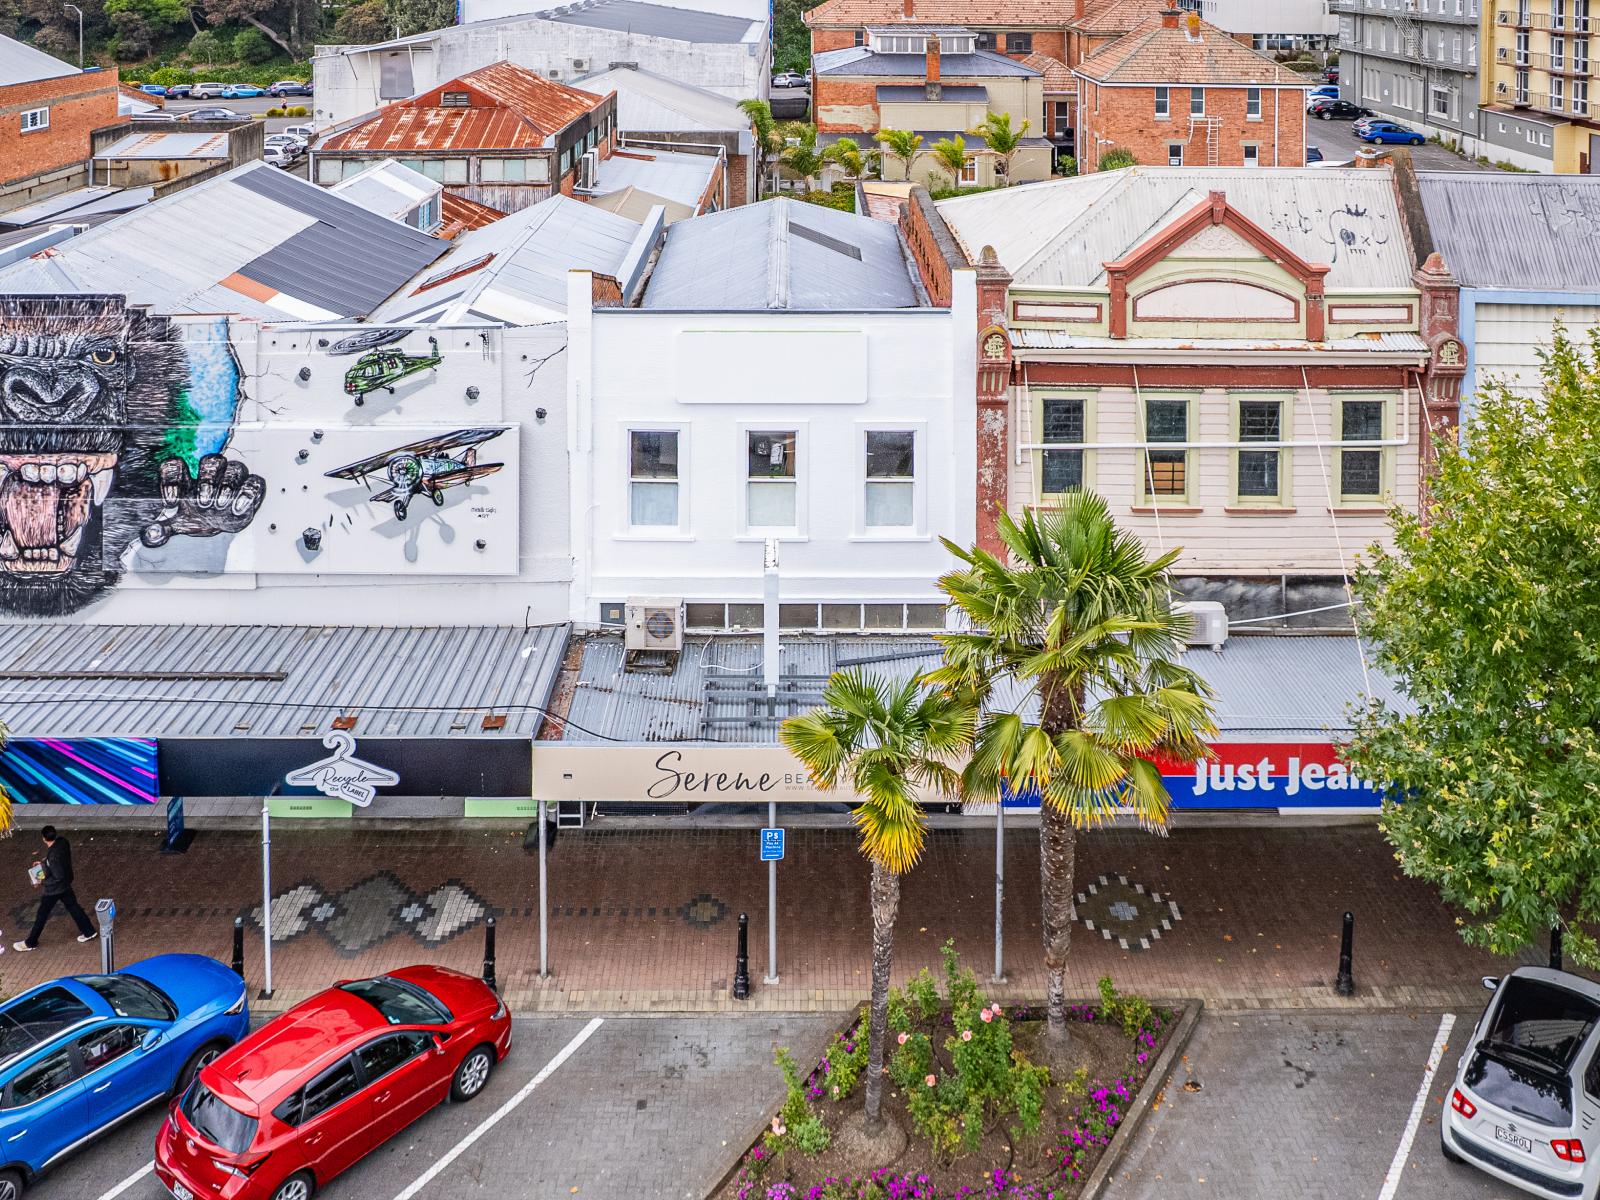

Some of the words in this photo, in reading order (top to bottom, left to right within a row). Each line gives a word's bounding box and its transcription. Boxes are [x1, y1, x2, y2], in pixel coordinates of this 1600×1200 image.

[311, 766, 369, 787] Recycle
[647, 750, 782, 798] Serene
[1192, 757, 1276, 796] Just
[346, 785, 366, 798] LABEL
